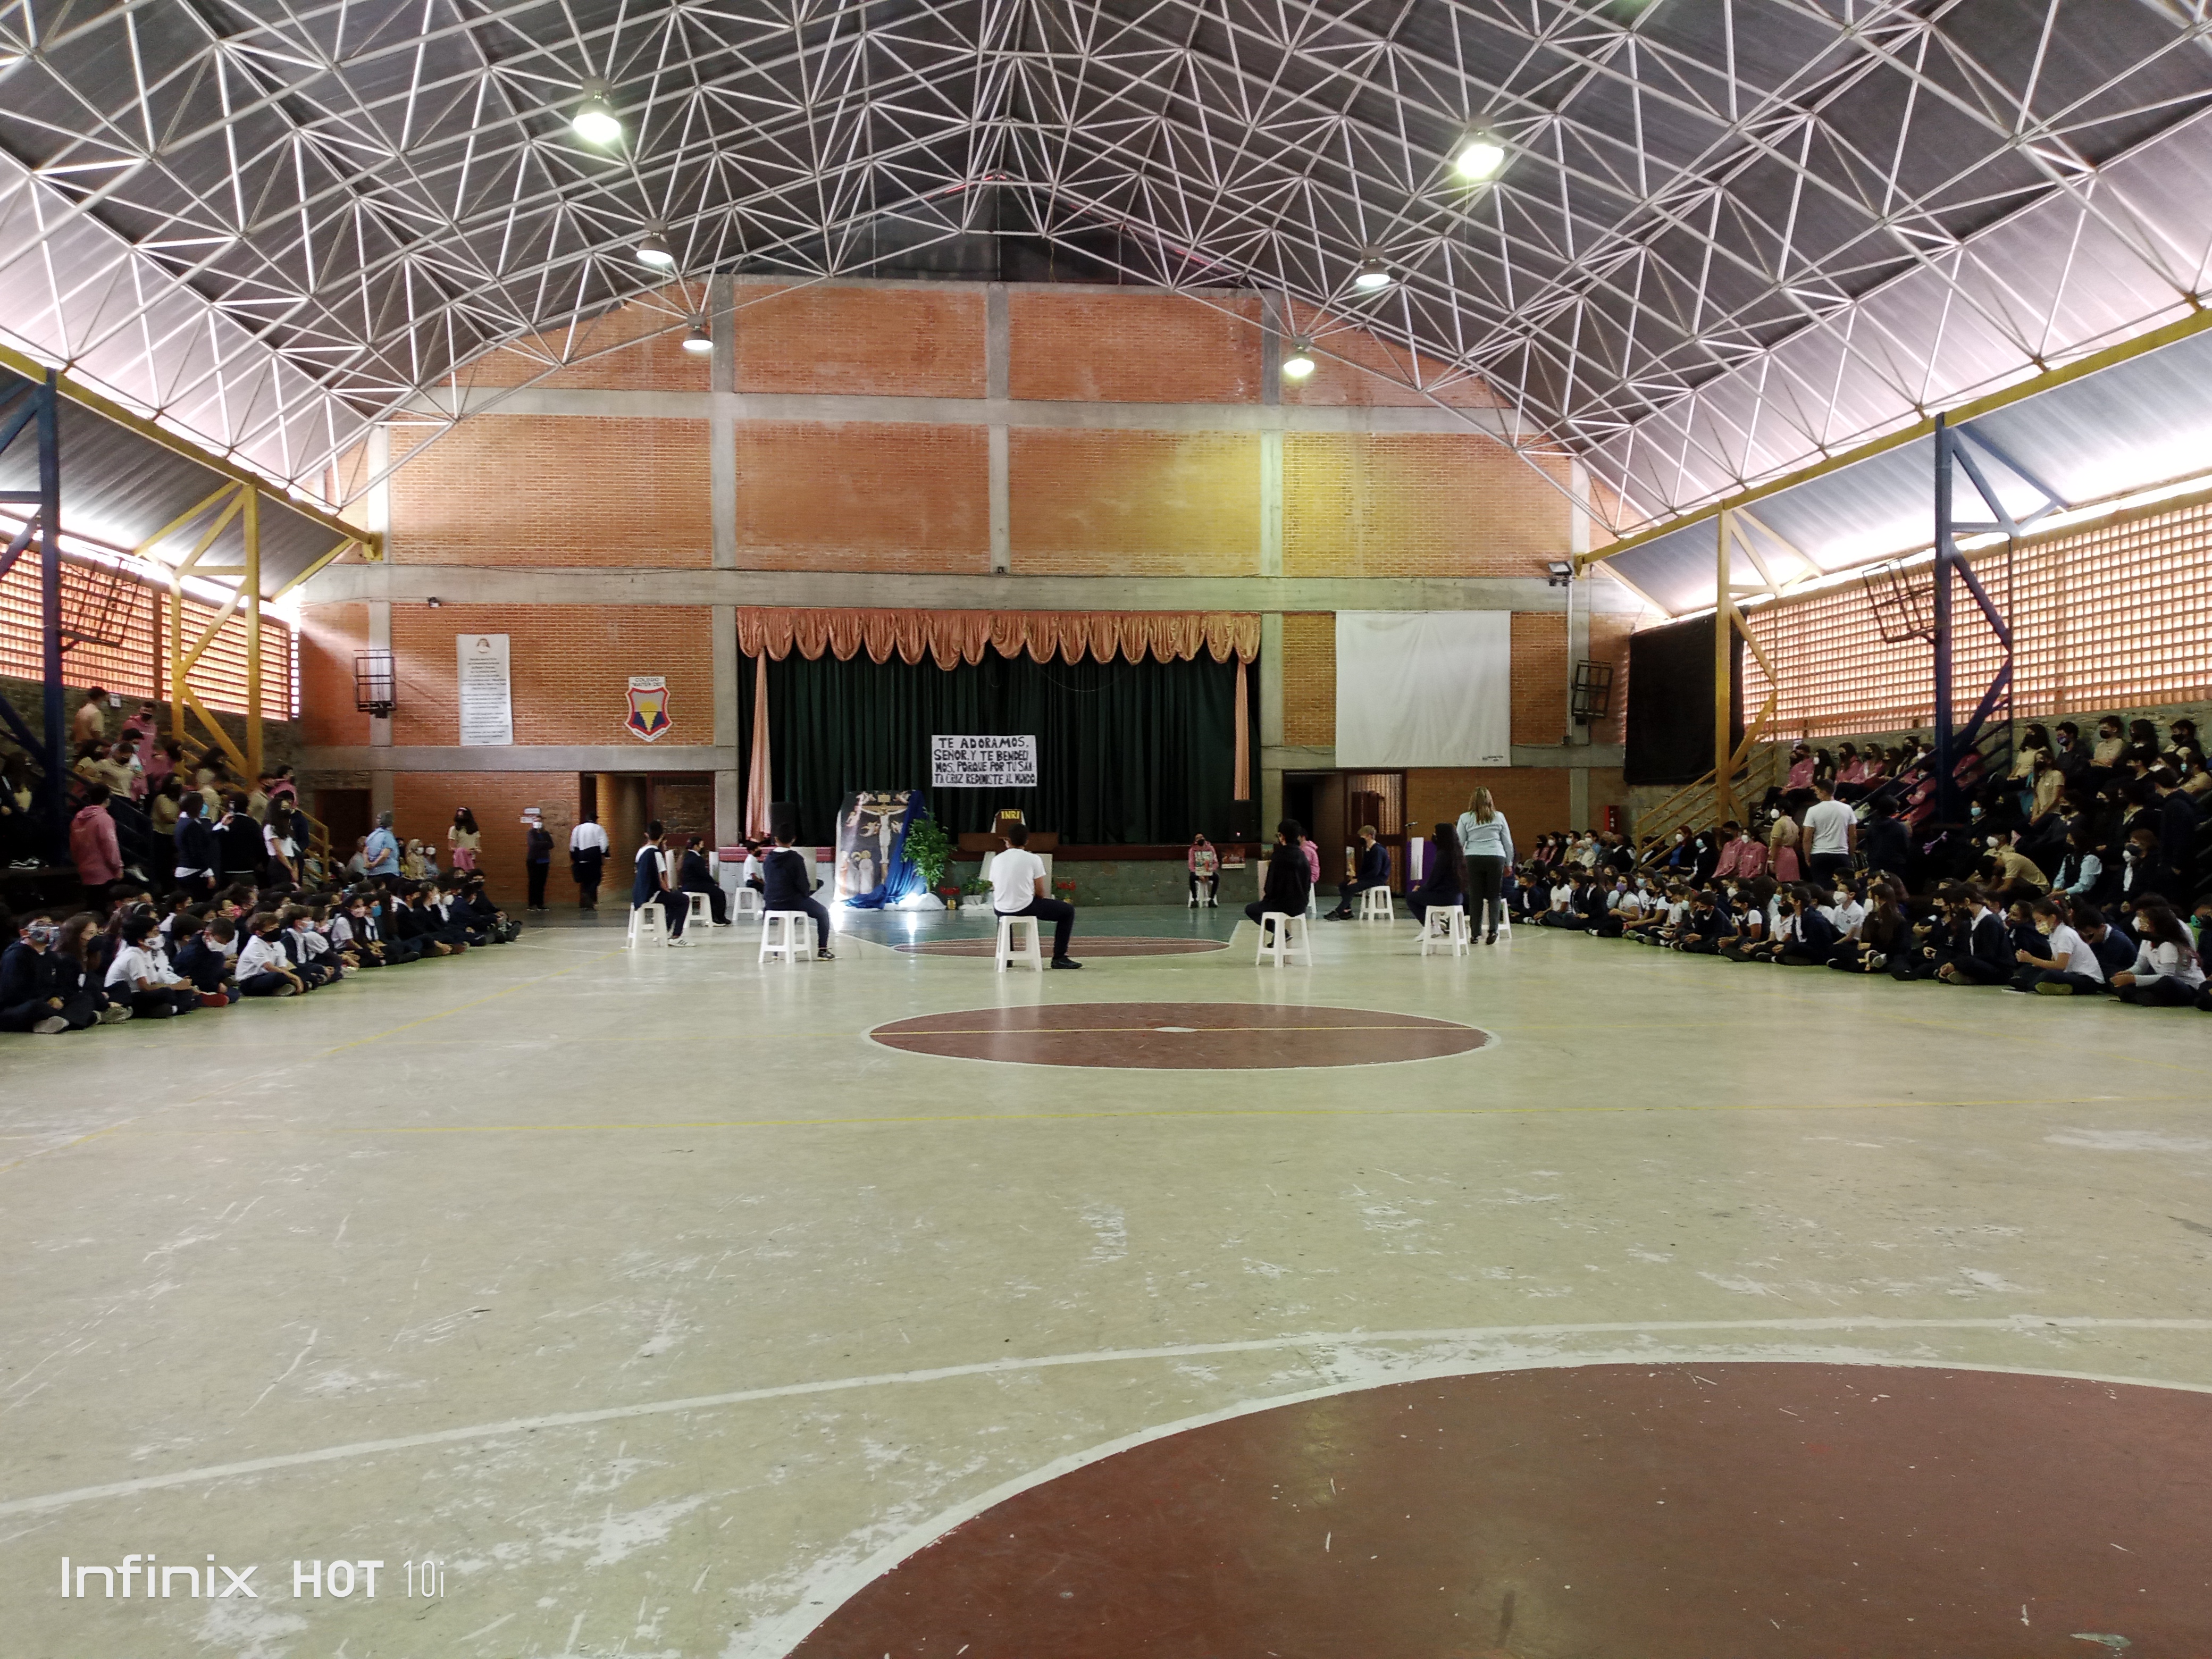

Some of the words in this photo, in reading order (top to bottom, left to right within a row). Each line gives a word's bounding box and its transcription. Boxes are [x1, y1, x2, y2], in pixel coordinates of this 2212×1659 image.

[939, 738, 953, 748] TE
[970, 750, 976, 760] Y
[980, 750, 993, 761] TE
[990, 761, 1004, 772] POR
[1001, 810, 1020, 819] INRI
